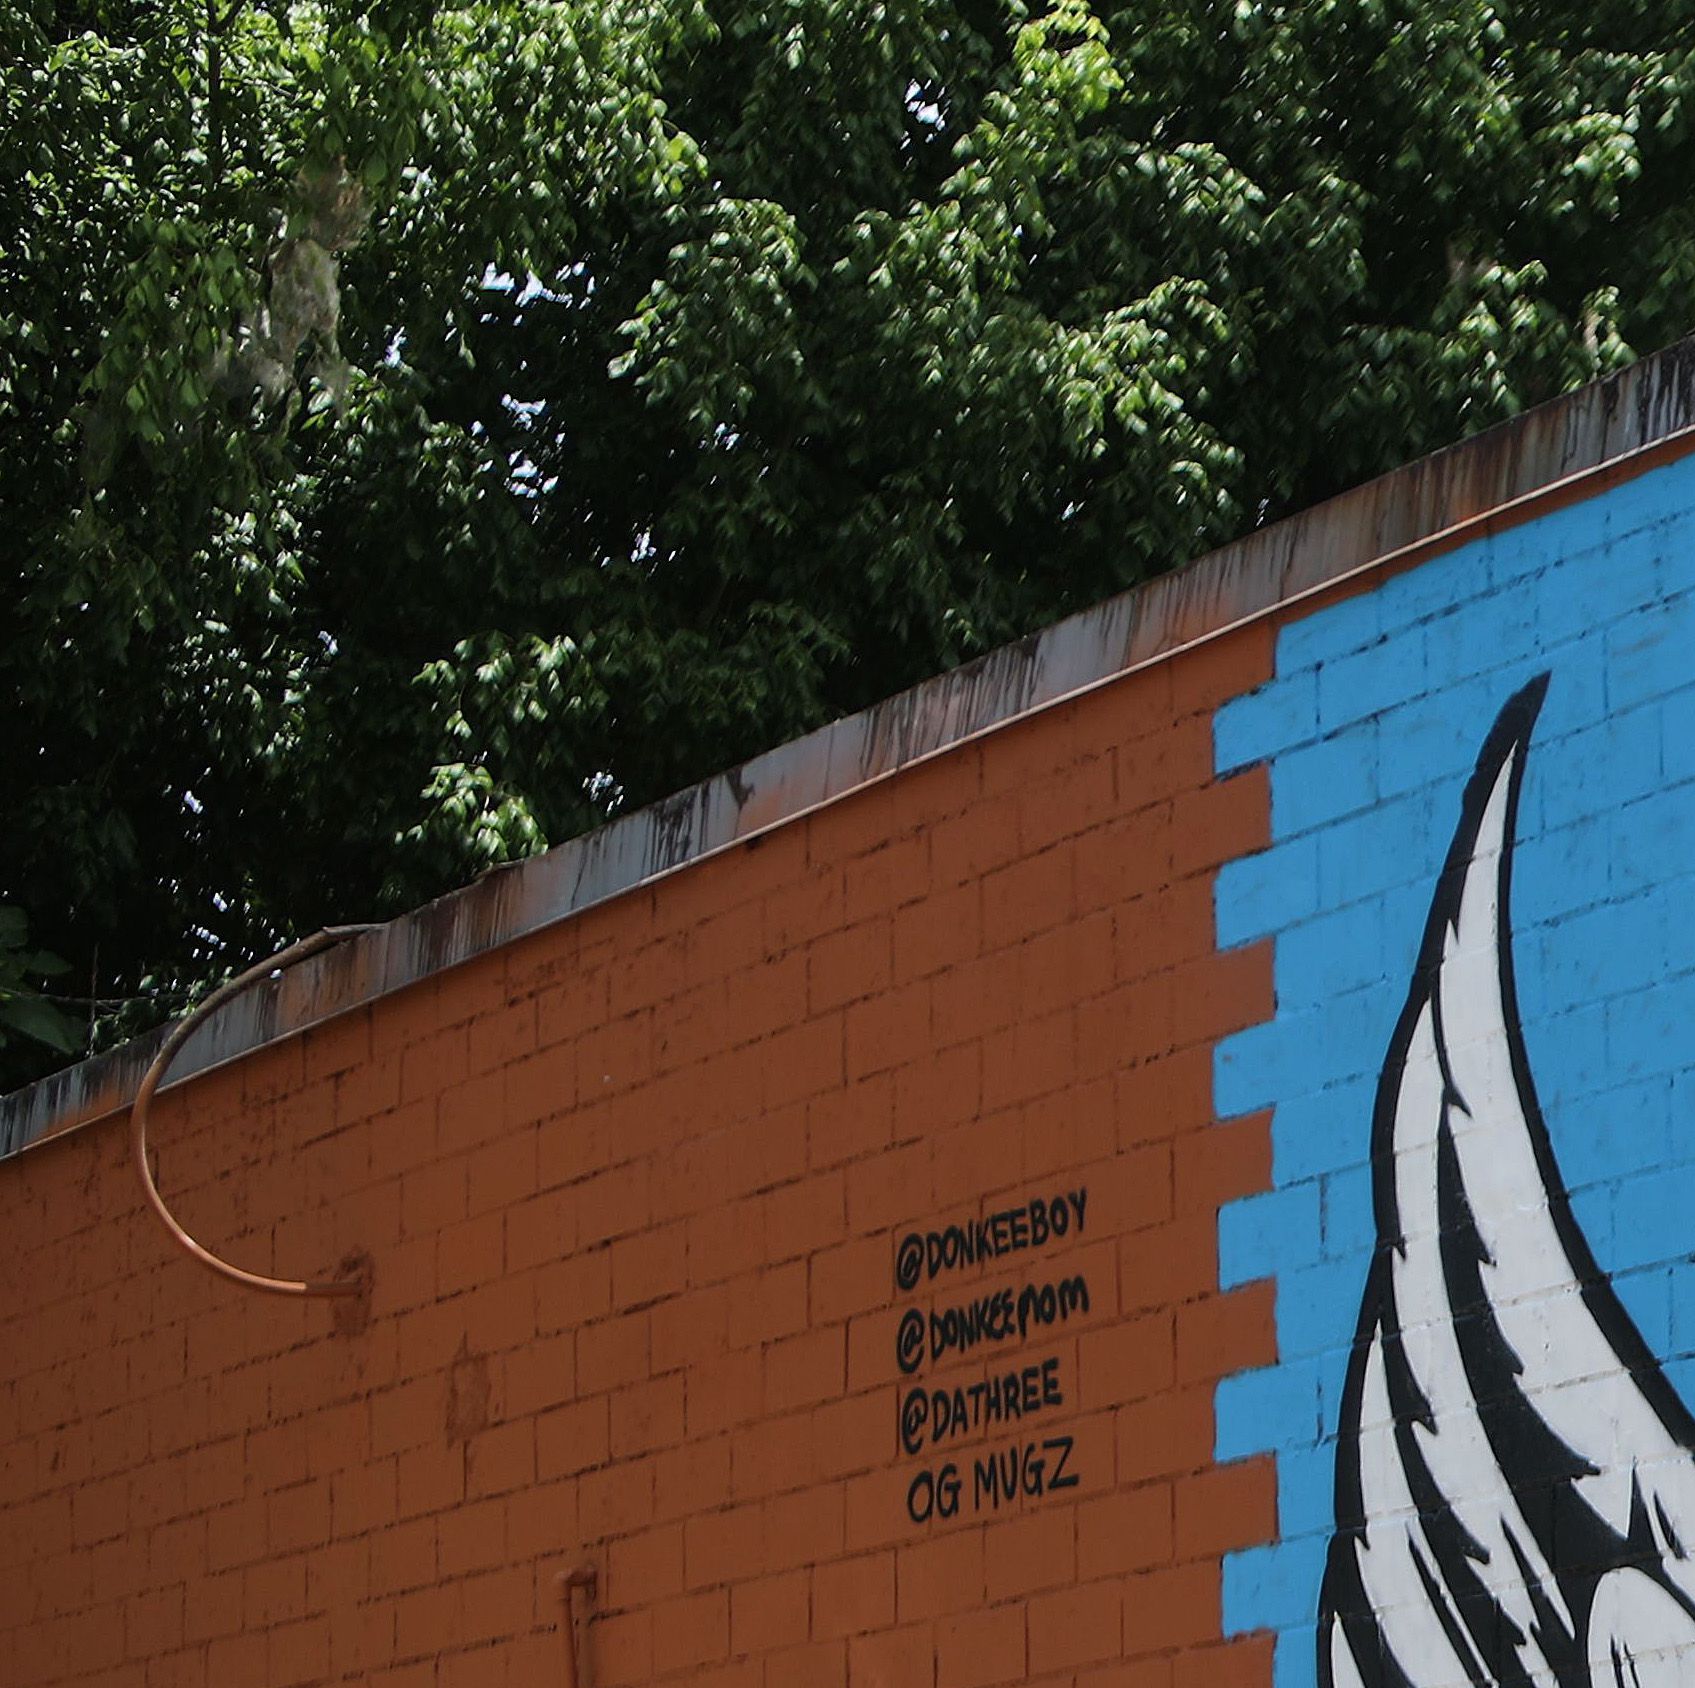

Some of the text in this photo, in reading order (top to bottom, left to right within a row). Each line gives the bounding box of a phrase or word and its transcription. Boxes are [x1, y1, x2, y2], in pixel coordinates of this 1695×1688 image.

[895, 1187, 1088, 1291] @DONKEEBOY
[900, 1356, 1064, 1455] @DATHREE
[906, 1436, 1080, 1523] OG MUGZ
